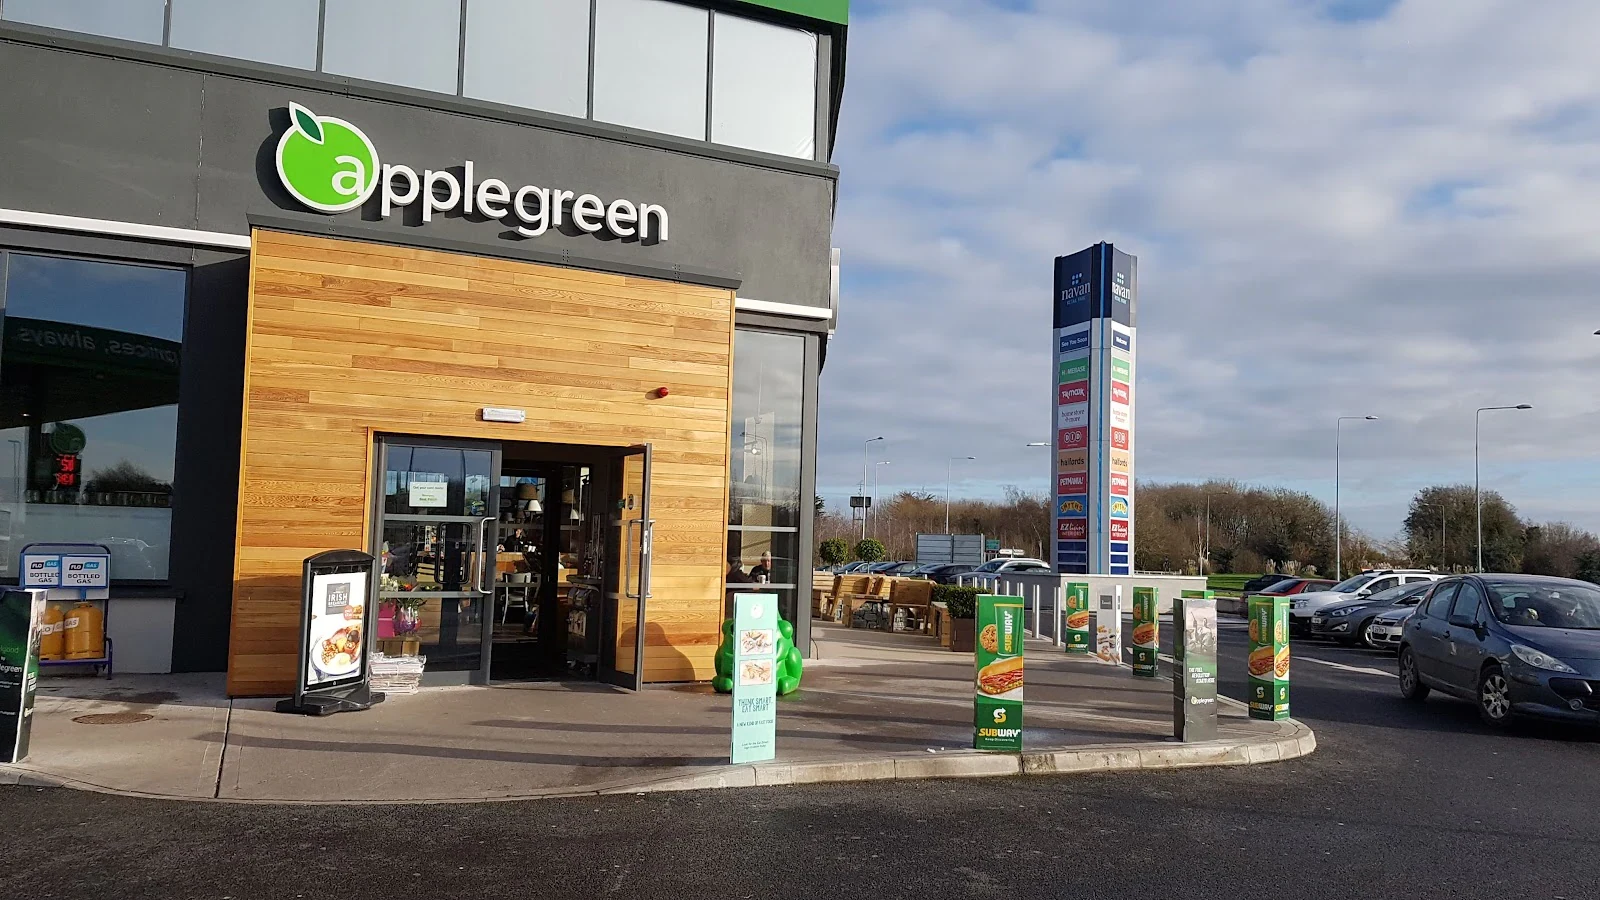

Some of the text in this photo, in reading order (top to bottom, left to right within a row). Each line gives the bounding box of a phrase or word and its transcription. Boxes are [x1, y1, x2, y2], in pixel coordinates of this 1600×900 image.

[331, 154, 669, 241] applegreen
[1062, 282, 1090, 300] navan
[1112, 282, 1130, 300] navan
[328, 593, 348, 601] IRISH
[1004, 610, 1013, 652] SUBWAY
[738, 698, 754, 706] THINK
[1250, 701, 1273, 711] SUBWAY
[978, 728, 1021, 737] SUBWAY
